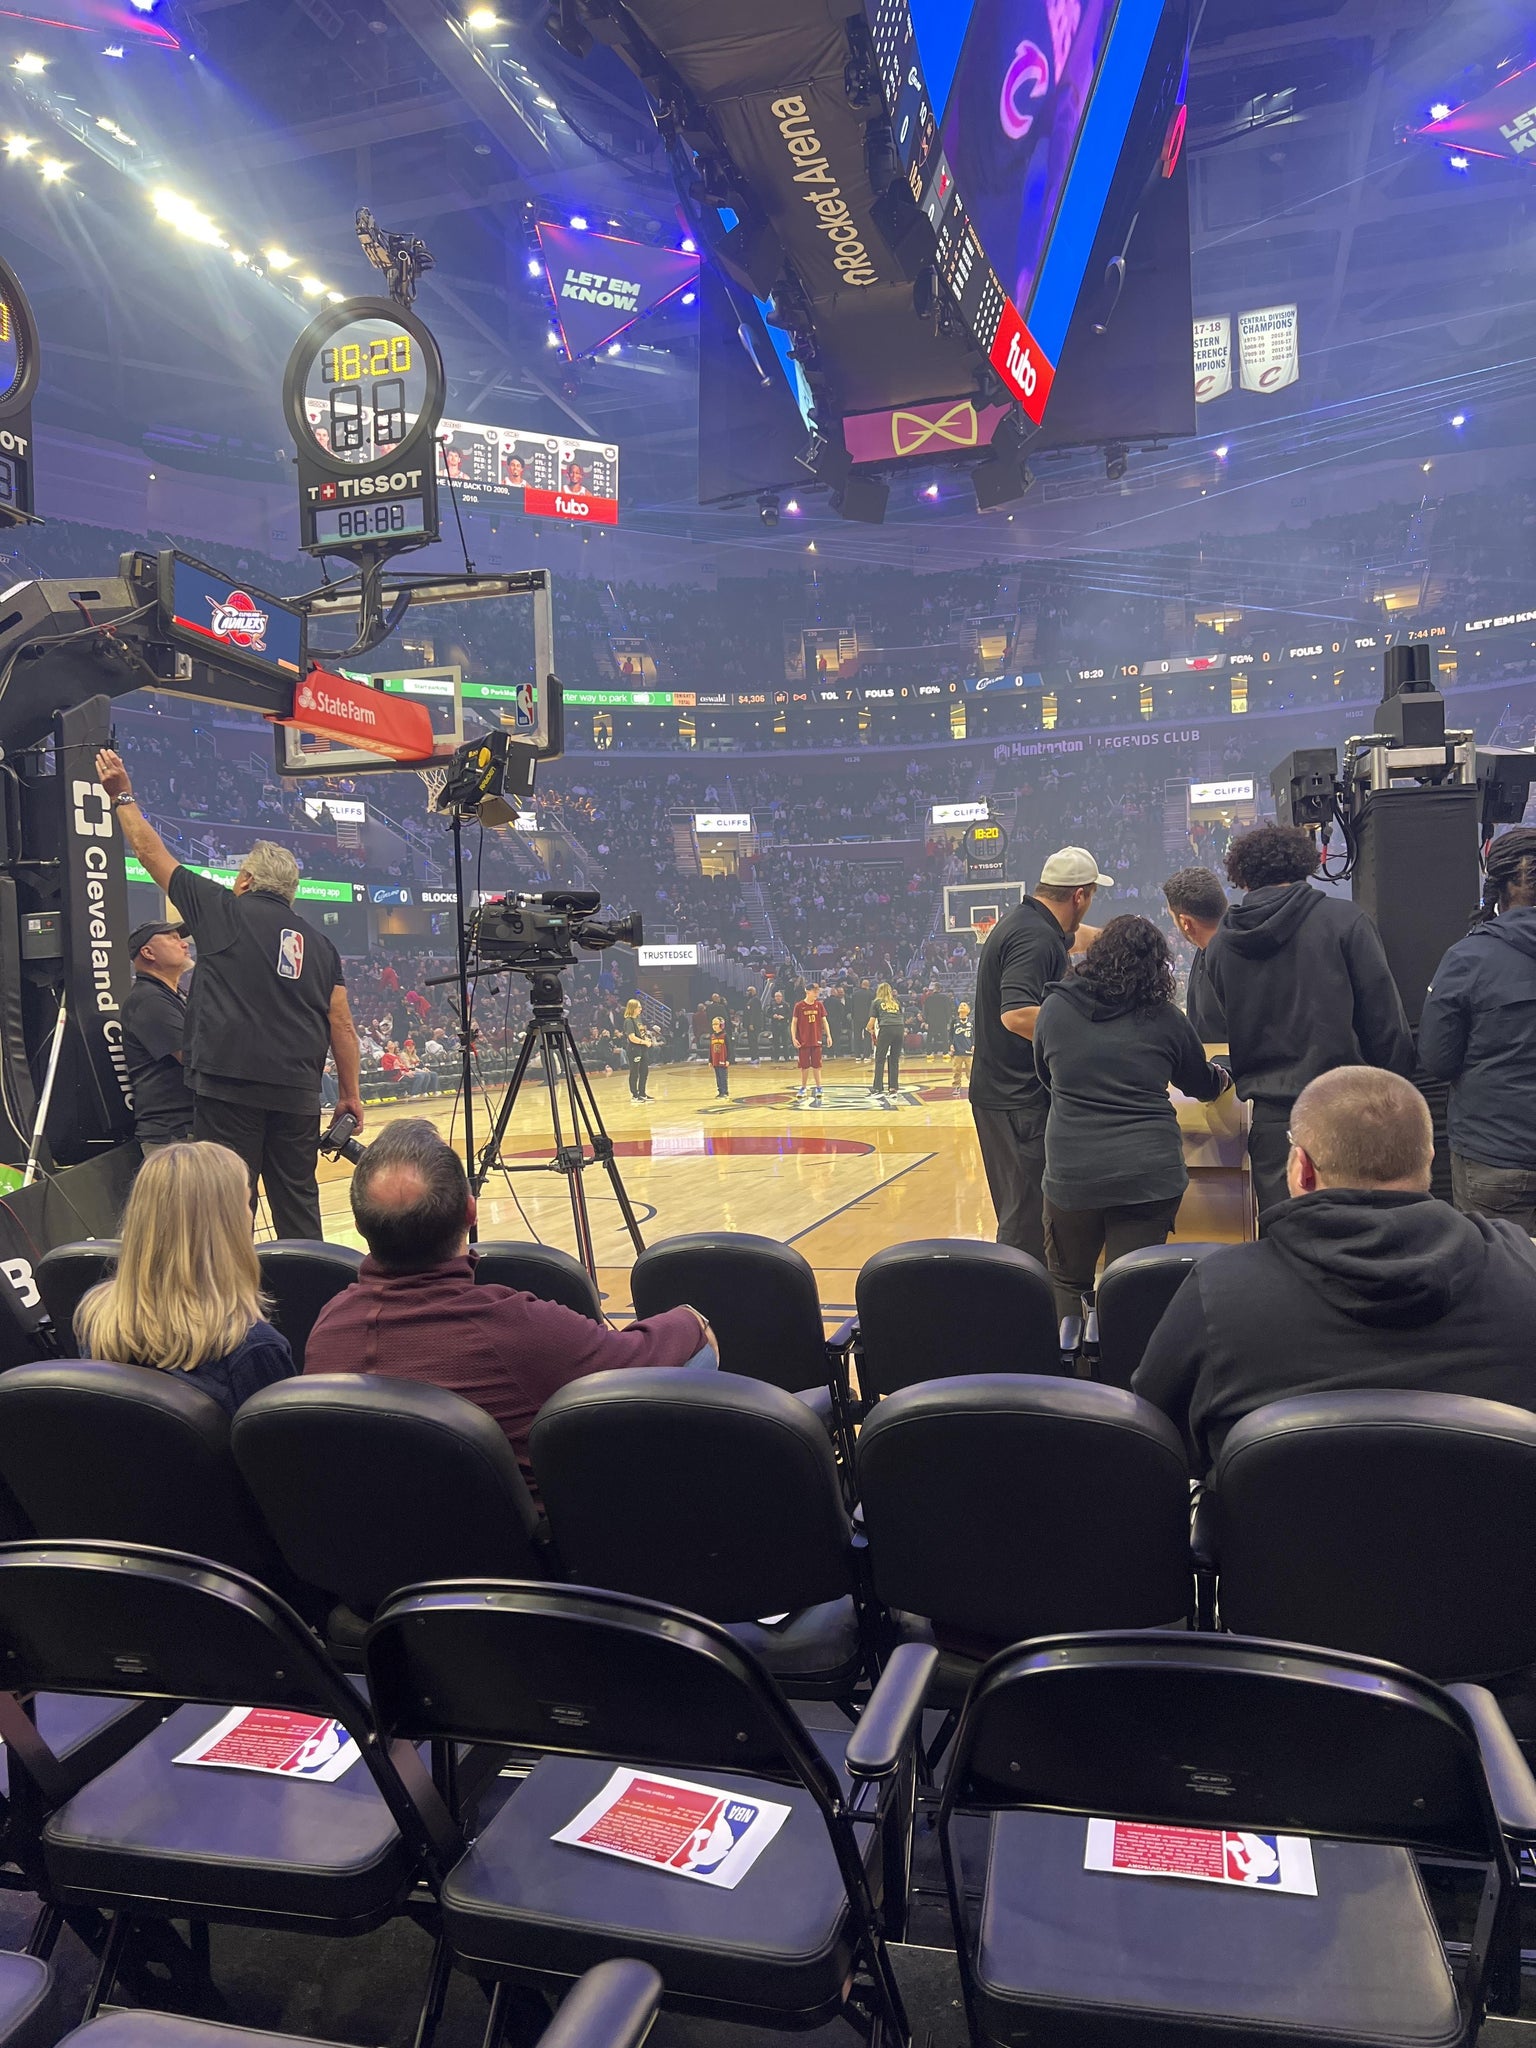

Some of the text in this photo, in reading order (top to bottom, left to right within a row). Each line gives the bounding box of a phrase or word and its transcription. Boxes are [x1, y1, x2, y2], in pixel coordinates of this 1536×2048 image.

[771, 95, 872, 270] Rocket Arena
[565, 268, 641, 297] LET EM
[561, 283, 638, 312] KNOW.
[1240, 310, 1296, 326] CENTRAL DIVISION
[1243, 318, 1293, 335] CHAMPIONS
[333, 335, 411, 382] 18:20
[1006, 330, 1038, 398] fubo
[338, 469, 422, 498] TISSOT
[463, 481, 481, 491] BACK
[482, 484, 492, 492] TO
[555, 496, 589, 516] fubo
[1465, 619, 1492, 631] LET
[1493, 615, 1515, 627] EM
[1408, 627, 1446, 640] 7:44 PM
[1355, 634, 1392, 648] TOL 7
[1290, 642, 1339, 658] FOULS 0
[1230, 653, 1270, 665] FG% 0
[1078, 665, 1138, 680] 18:20 1Q
[1161, 662, 1169, 672] 0
[1015, 676, 1023, 686] 0
[865, 688, 908, 698] FOULS 0
[920, 683, 956, 695] FG% 0
[580, 694, 596, 703] way
[609, 694, 628, 703] park
[700, 693, 726, 703] oswald
[821, 691, 853, 701] TOL 7
[1164, 729, 1200, 743] CLUB
[1214, 786, 1250, 795] CLIFFS
[330, 806, 362, 816] CLIFFS
[954, 807, 987, 817] CLIFFS
[716, 819, 748, 827] CLIFFS
[975, 827, 999, 839] 18:20
[979, 862, 1003, 870] TISSOT
[302, 886, 341, 898] parking app
[356, 893, 363, 902] 0
[400, 889, 408, 903] 0
[421, 892, 458, 903] BLOCKS
[85, 846, 119, 1012] Cleveland
[643, 950, 694, 960] TRUSTEDSEC
[728, 1804, 756, 1823] NBA
